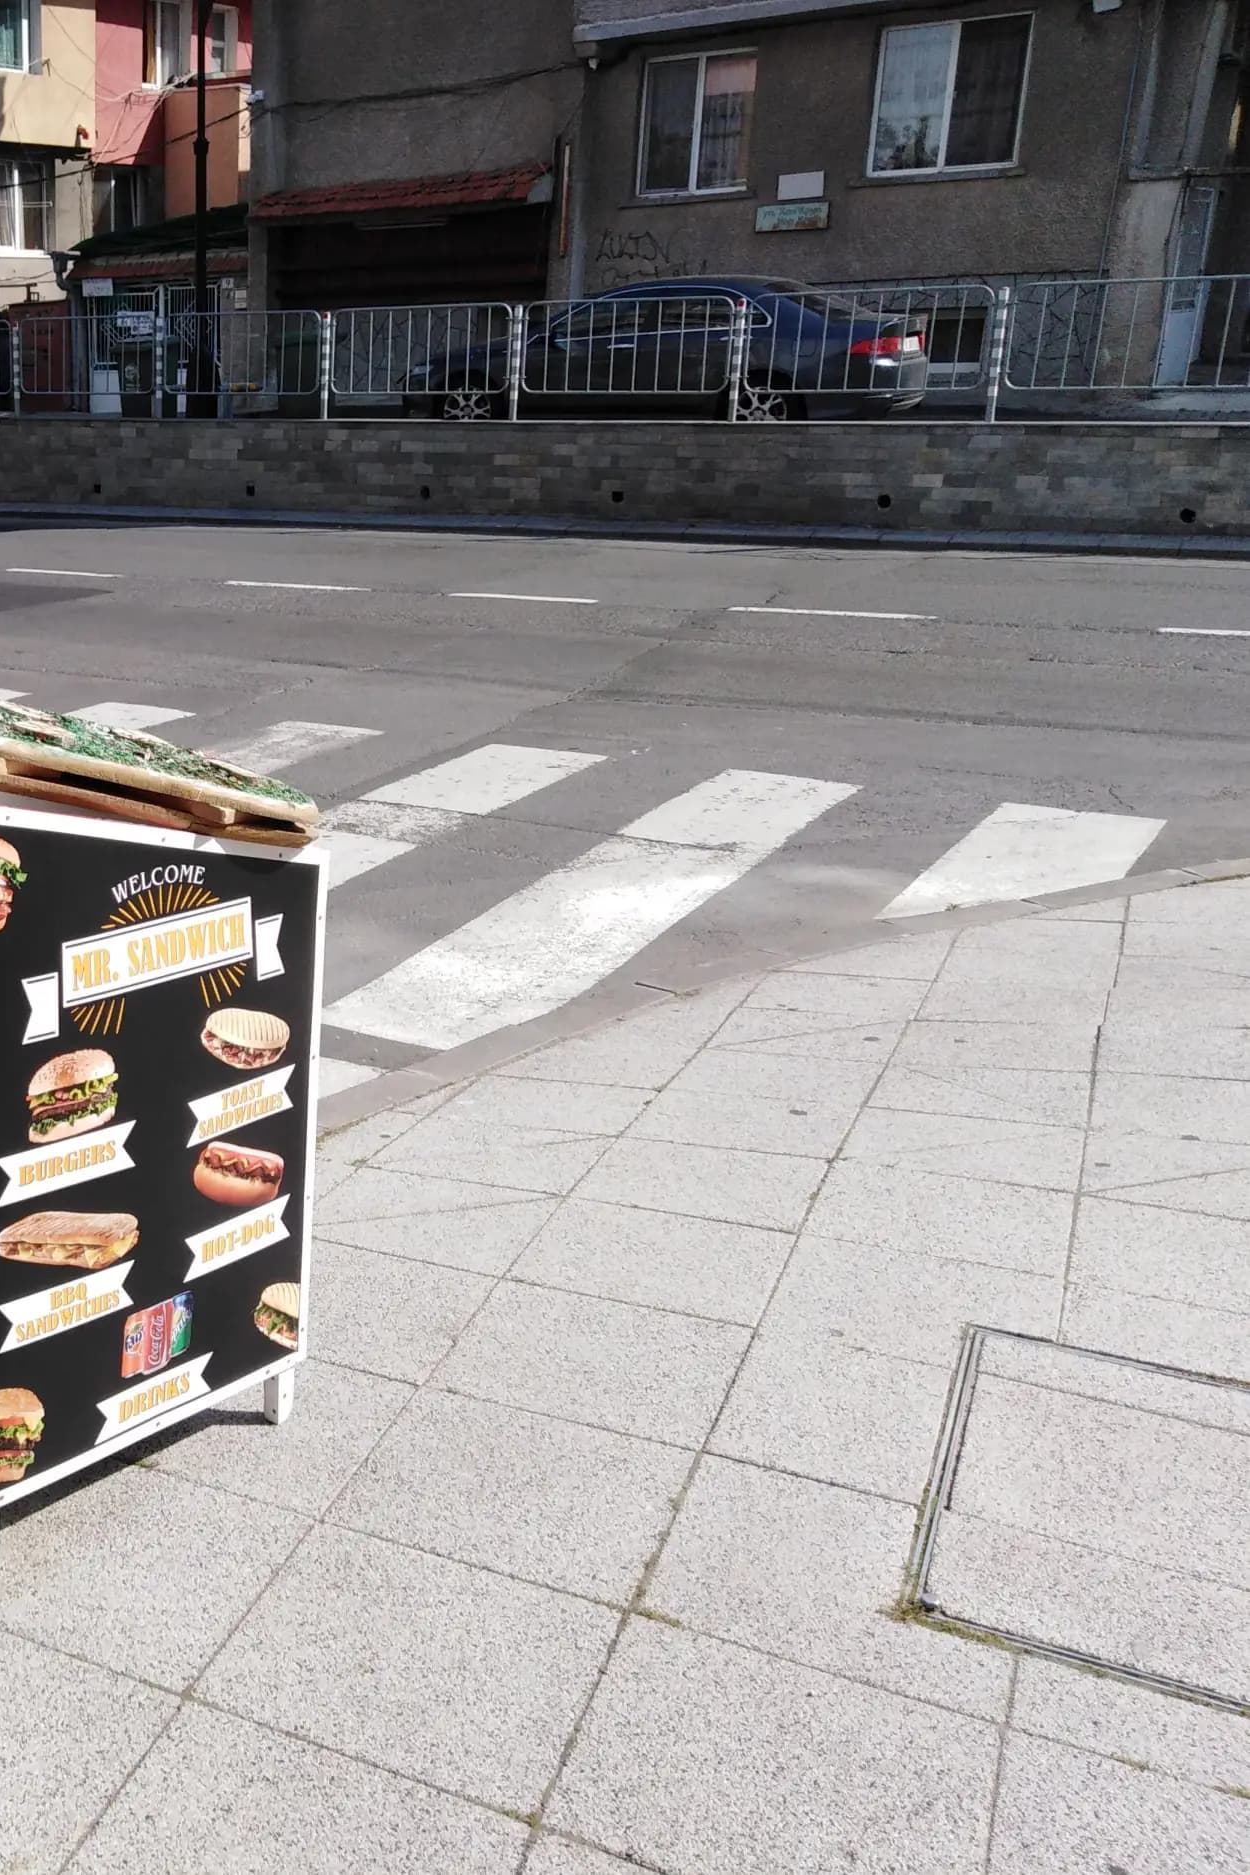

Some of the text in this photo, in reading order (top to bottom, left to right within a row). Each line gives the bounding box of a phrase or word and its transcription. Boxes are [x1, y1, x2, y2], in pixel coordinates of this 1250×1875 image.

[111, 864, 206, 903] WELCOME
[71, 913, 246, 992] MR. SANDWICH
[197, 1091, 284, 1138] SANDWICHES
[221, 1079, 265, 1109] TOAST
[18, 1140, 117, 1187] BURGERS
[201, 1214, 276, 1263] HOT-DOG
[14, 1290, 120, 1343] SANDWICHES
[49, 1281, 88, 1311] BBQ
[118, 1371, 191, 1425] DRINKS
